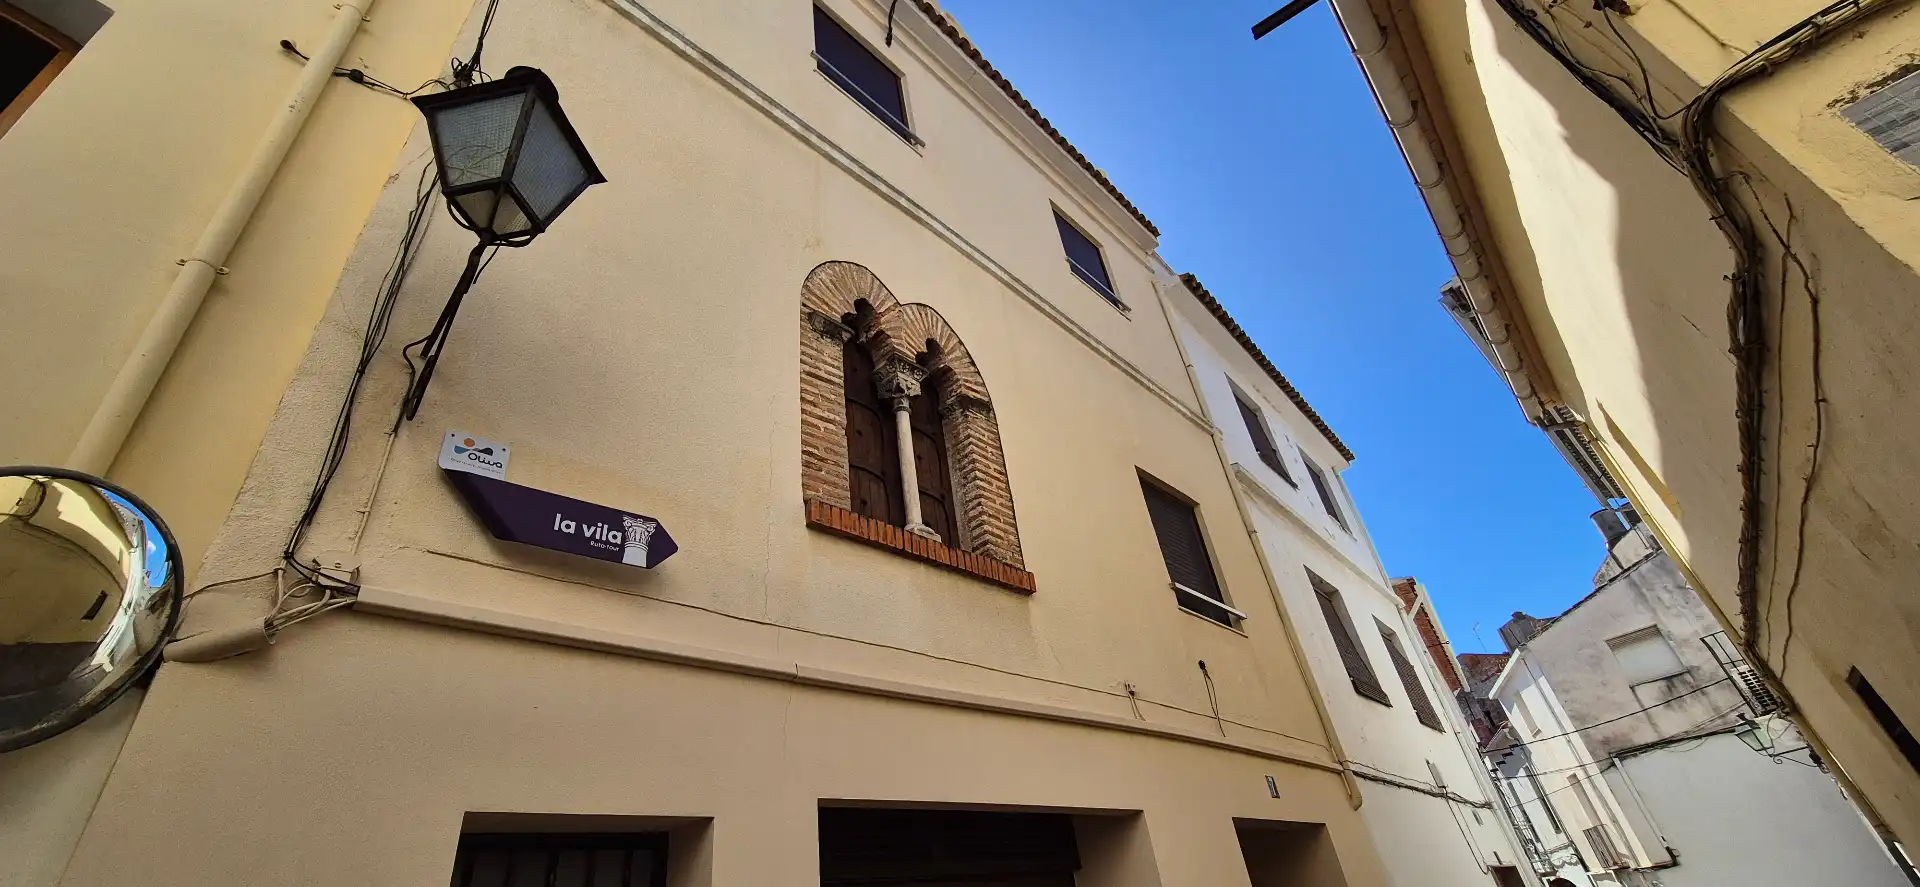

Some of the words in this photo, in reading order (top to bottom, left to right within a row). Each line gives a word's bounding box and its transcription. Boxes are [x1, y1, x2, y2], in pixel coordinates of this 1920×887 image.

[467, 452, 503, 469] Oliva
[553, 513, 576, 534] la
[582, 522, 622, 544] vila
